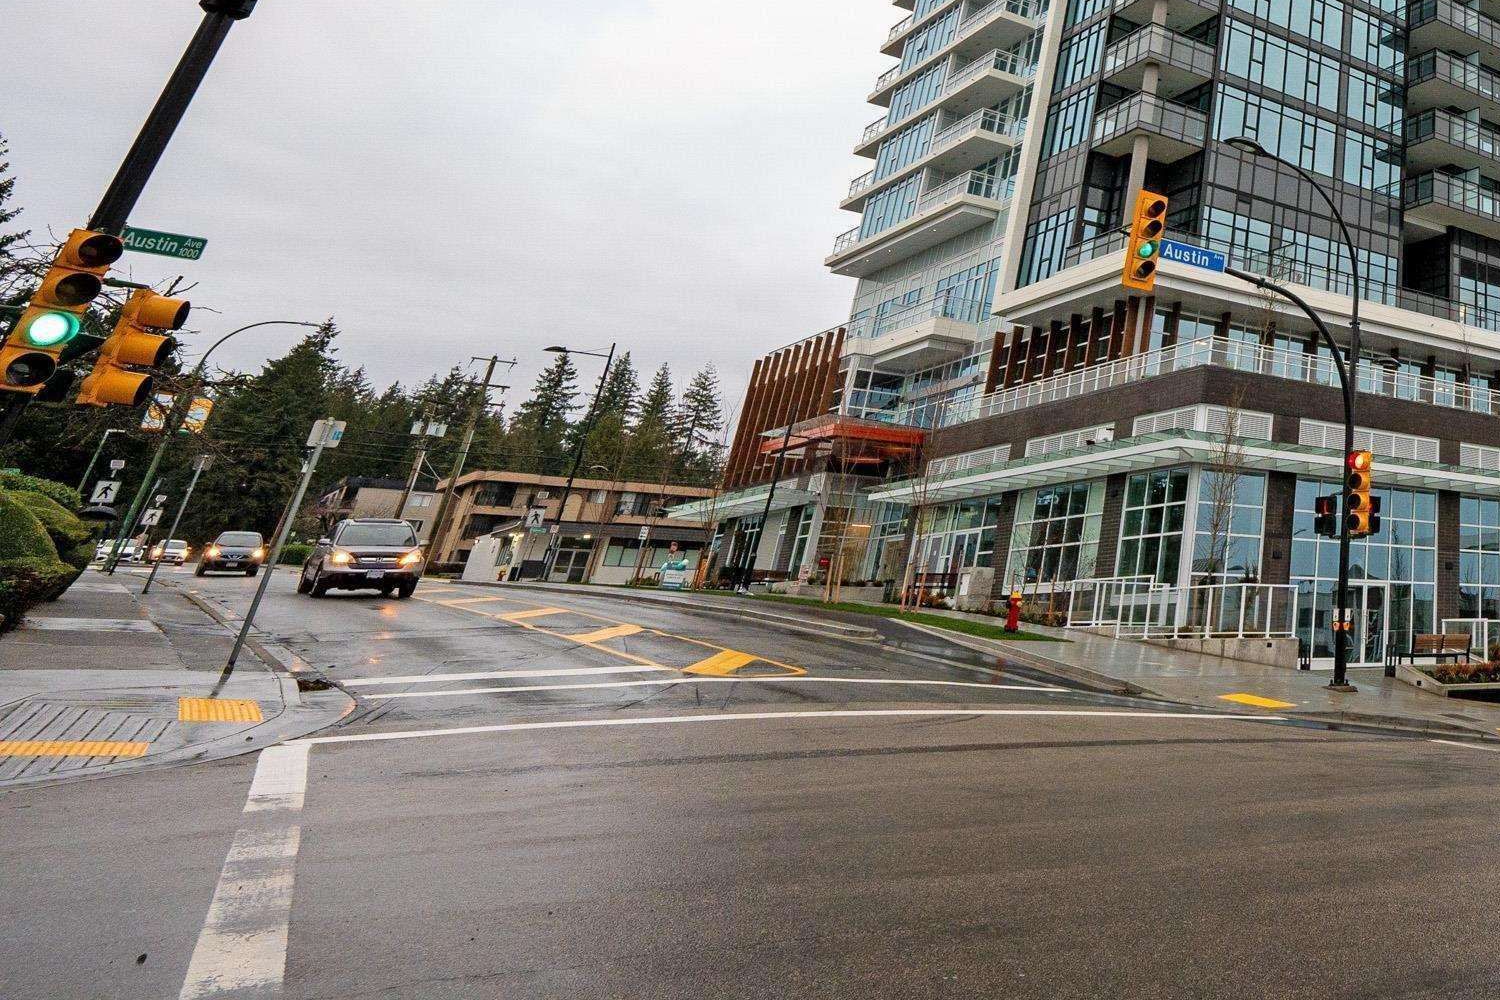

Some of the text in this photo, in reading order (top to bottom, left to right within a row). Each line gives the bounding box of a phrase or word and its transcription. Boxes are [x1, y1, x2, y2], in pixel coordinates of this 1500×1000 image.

[123, 231, 203, 252] Austin Ave
[179, 247, 199, 259] 1000
[1164, 243, 1209, 266] Austin
